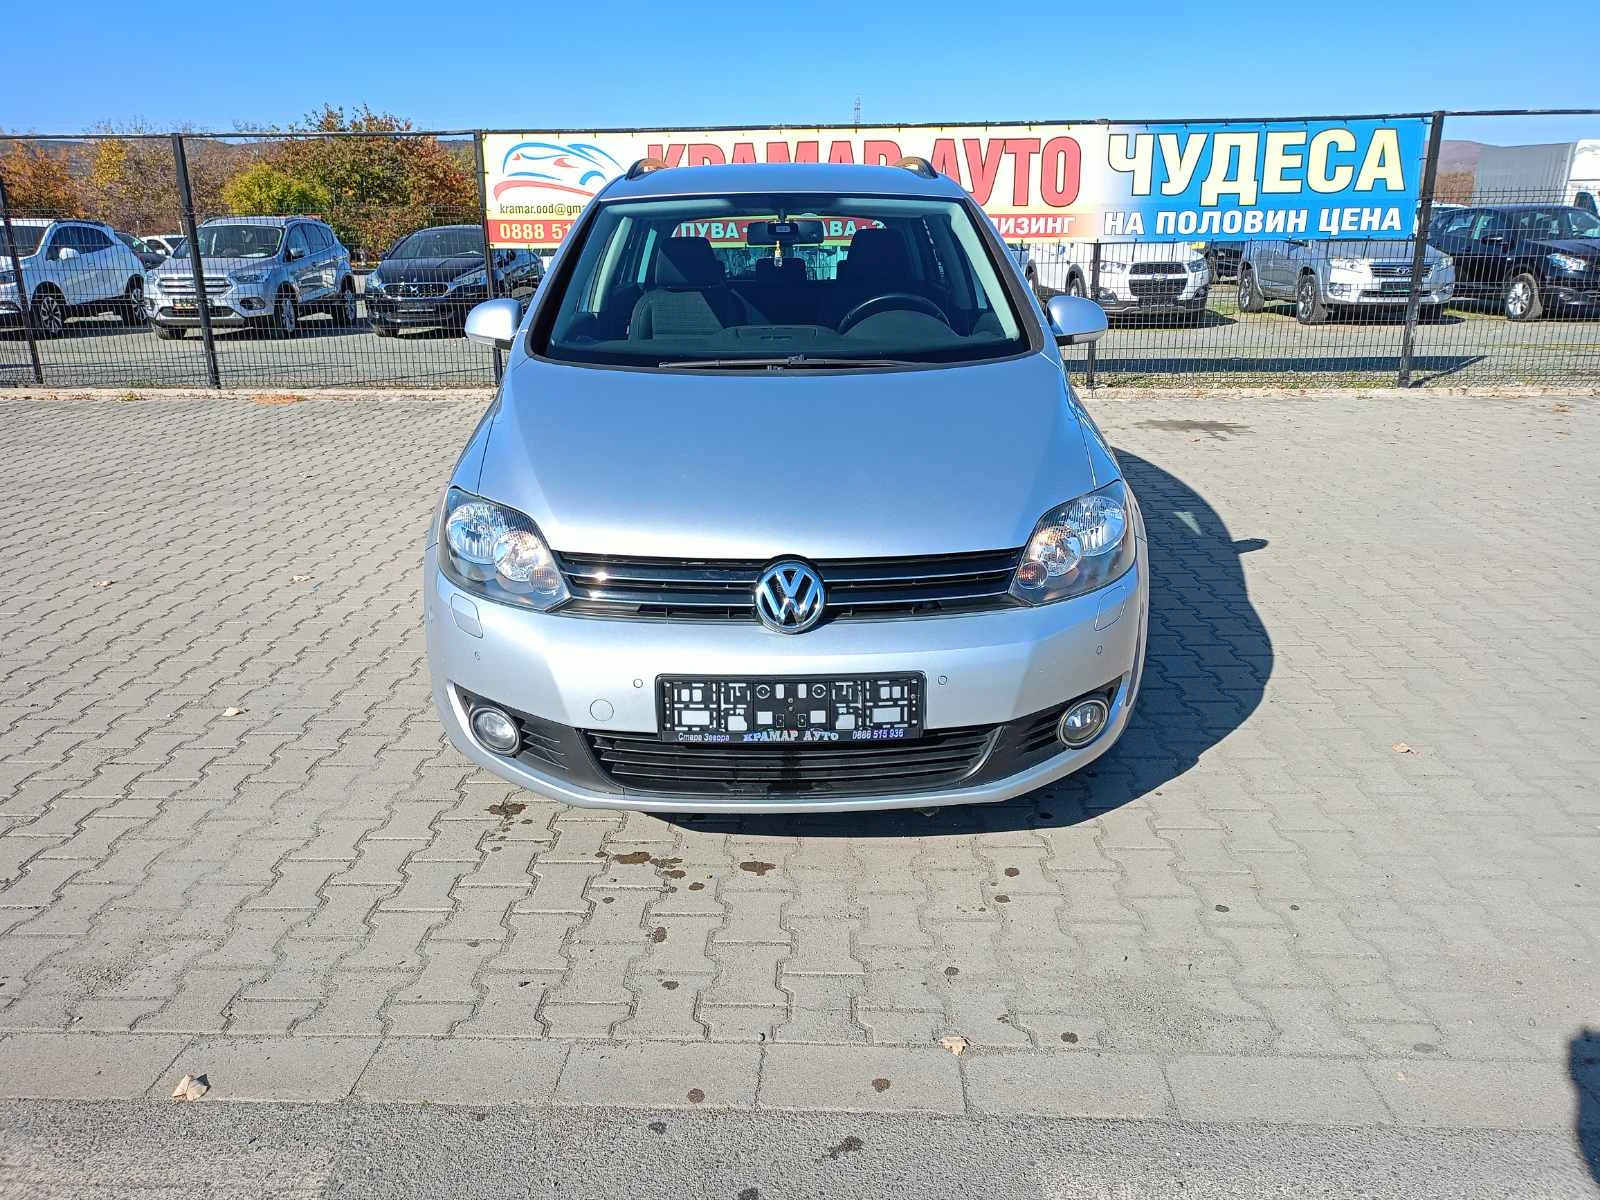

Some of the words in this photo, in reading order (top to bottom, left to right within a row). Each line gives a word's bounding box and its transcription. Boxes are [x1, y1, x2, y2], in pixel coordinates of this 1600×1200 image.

[931, 136, 1082, 208] АУТО
[1107, 128, 1406, 207] ЧУДЕСА
[500, 223, 545, 240] 0888
[1103, 211, 1145, 236] НА
[1155, 208, 1308, 235] ПОЛОВИН
[1317, 207, 1402, 236] ЦЕНА
